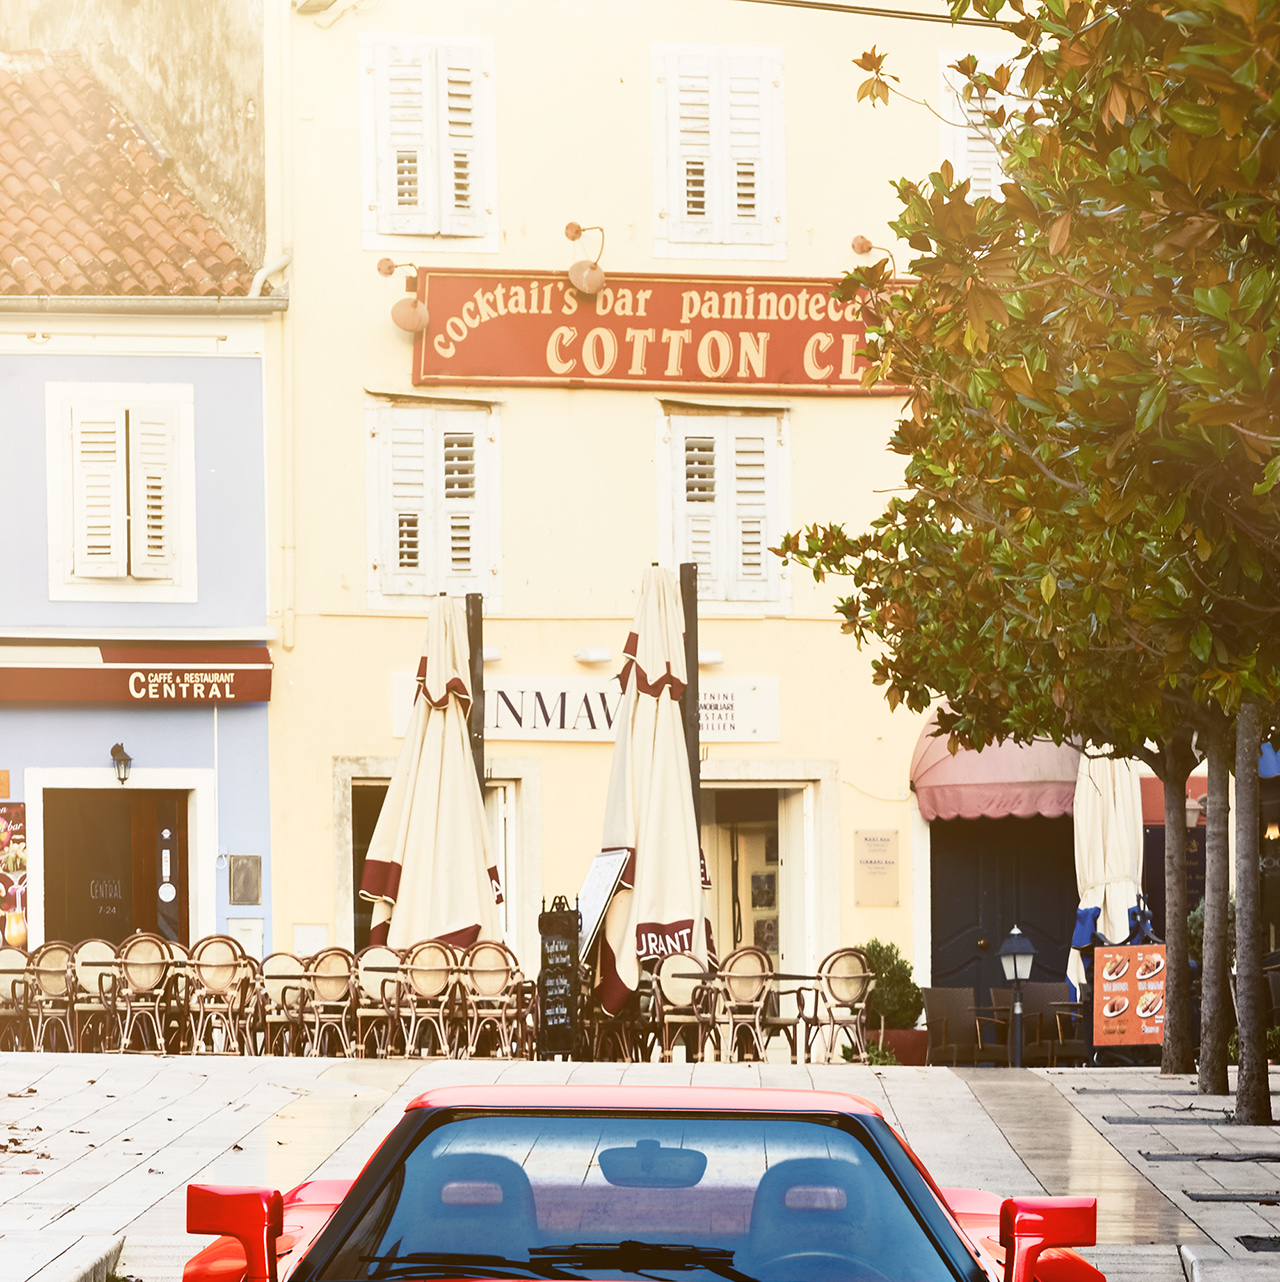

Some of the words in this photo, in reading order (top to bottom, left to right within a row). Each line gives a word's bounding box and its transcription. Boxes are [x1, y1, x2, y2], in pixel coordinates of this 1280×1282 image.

[433, 281, 579, 359] cocktail's
[595, 287, 653, 316] bar
[680, 287, 863, 324] paninoteca
[546, 325, 770, 379] COTTON
[803, 332, 866, 381] CL
[128, 671, 236, 699] CENTRAL
[184, 672, 235, 684] RESTAURANT
[699, 693, 734, 701] TNINE
[7, 820, 24, 832] bar
